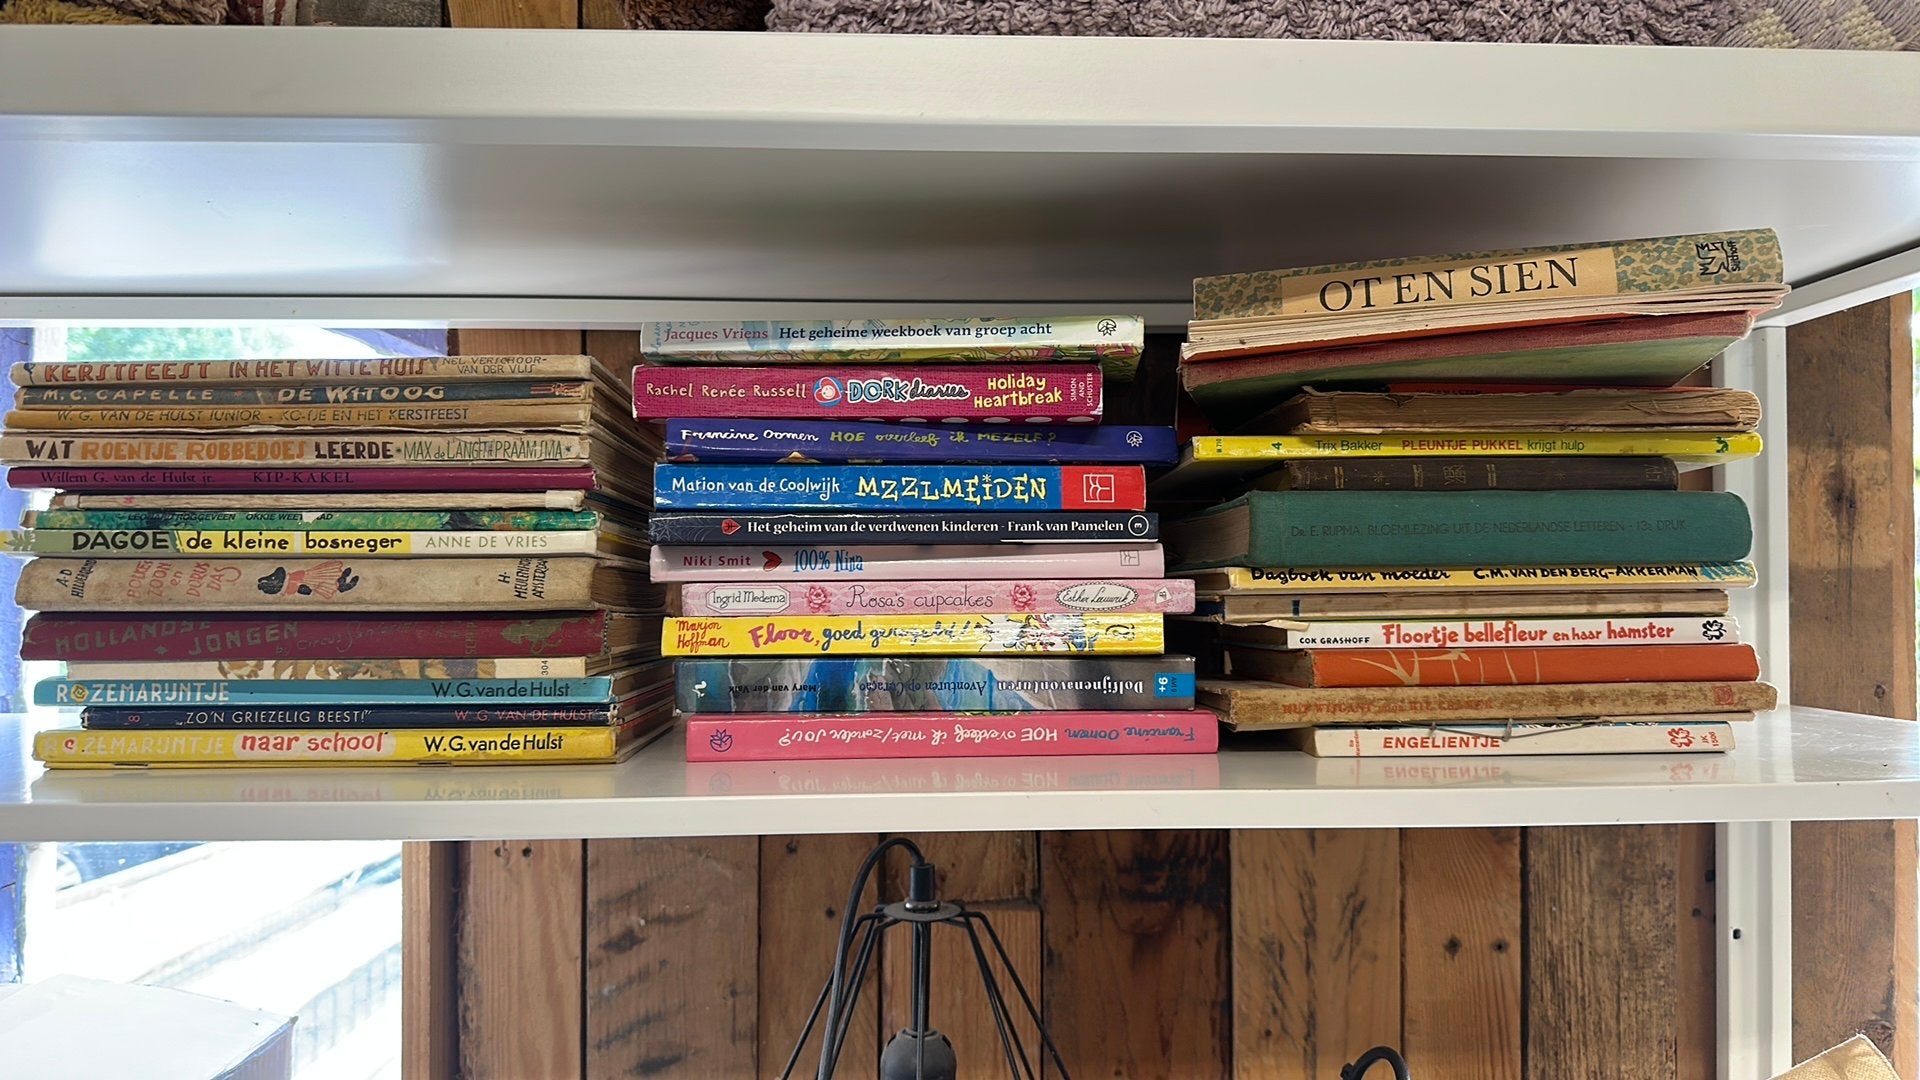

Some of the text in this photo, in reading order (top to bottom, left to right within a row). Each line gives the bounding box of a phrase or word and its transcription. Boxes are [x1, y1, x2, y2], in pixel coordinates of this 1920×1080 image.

[1319, 257, 1577, 312] OT EN SIEN
[664, 328, 718, 342] Jacques
[722, 328, 768, 339] Vriens
[779, 323, 1052, 341] Het geheime weekboek van groep acht
[442, 357, 467, 365] NEL
[44, 358, 426, 382] KERSTFEEST IN HET WITTE HUIS
[458, 365, 478, 374] VAN
[483, 365, 504, 374] DER
[909, 378, 970, 401] diaries
[987, 373, 1046, 391] Holiday
[43, 389, 214, 400] M. C. CAPELLE
[277, 388, 312, 401] DE
[646, 383, 806, 398] Rachel Renée Russell
[974, 386, 1063, 408] Heartbreak
[57, 408, 469, 421] W. G. VAN DE HULST JUNIOR EN HET KERSTFEEST
[681, 429, 819, 442] Francine Oomen
[830, 431, 968, 447] HOE overleef ik
[26, 440, 394, 460] WAT ROENTJE ROBBEDOES LEERDE
[404, 441, 445, 459] MAX de
[1272, 442, 1282, 450] 4
[1315, 439, 1584, 452] Trix Bakker PLEUNTJE PUKKEL krijgt hulp
[41, 472, 196, 483] Willem G. van de Hulst
[254, 472, 354, 483] KIP-KAKEL
[672, 477, 840, 500] Marion van de Coolwijk
[246, 513, 276, 521] OKKIE
[748, 522, 770, 533] Het
[773, 522, 822, 535] geheim
[825, 524, 848, 533] van
[851, 522, 866, 533] de
[868, 521, 939, 533] verdwenen
[942, 521, 998, 532] kinderen
[1008, 521, 1044, 532] Frank
[1045, 523, 1068, 532] van
[1071, 521, 1124, 532] Pamelen
[1453, 522, 1471, 535] UIT
[1475, 522, 1489, 533] DE
[1493, 521, 1570, 533] NEDERLANDSE
[1657, 519, 1687, 531] DRUK
[73, 531, 402, 552] DAGOE de kleine bosneger
[425, 535, 548, 548] ANNE DE VRIES
[684, 555, 751, 567] Niki Smit
[793, 550, 863, 572] 100% Nina
[148, 562, 172, 597] ZOON
[172, 571, 183, 586] en
[208, 566, 242, 593] DAS
[1251, 565, 1698, 584] Dagboek van moeder C.M. VAN DEN BERG-AKKERMAN
[713, 591, 786, 608] Ingrid Medema
[847, 584, 993, 614] Rosa's cupcakes
[1063, 589, 1089, 602] Esther
[676, 620, 721, 639] Marjon
[748, 621, 865, 652] Floor, goed
[1382, 620, 1674, 647] Floortje bellefleur en haar hamster
[188, 622, 299, 655] JONGEN
[678, 634, 730, 653] Hoffman
[1300, 636, 1370, 645] COK GRASHOFF
[541, 660, 549, 676] 304
[530, 681, 570, 697] Hulst
[729, 683, 817, 694] Mary van der Valk
[905, 675, 1144, 695] Dolfijnenavonturen Avonturen op
[1158, 677, 1168, 693] 9+
[232, 711, 310, 723] GRIEZELIG
[494, 709, 594, 721] VAN DE HULST
[523, 733, 563, 750] Hulst
[779, 728, 826, 746] JOU?
[931, 728, 948, 745] ik
[955, 724, 1017, 743] overleef
[1021, 728, 1058, 741] HOE
[1065, 728, 1119, 739] Oomen
[1126, 726, 1195, 741] Francine
[241, 732, 383, 752] naar school
[1383, 736, 1500, 748] ENGELIENTJE
